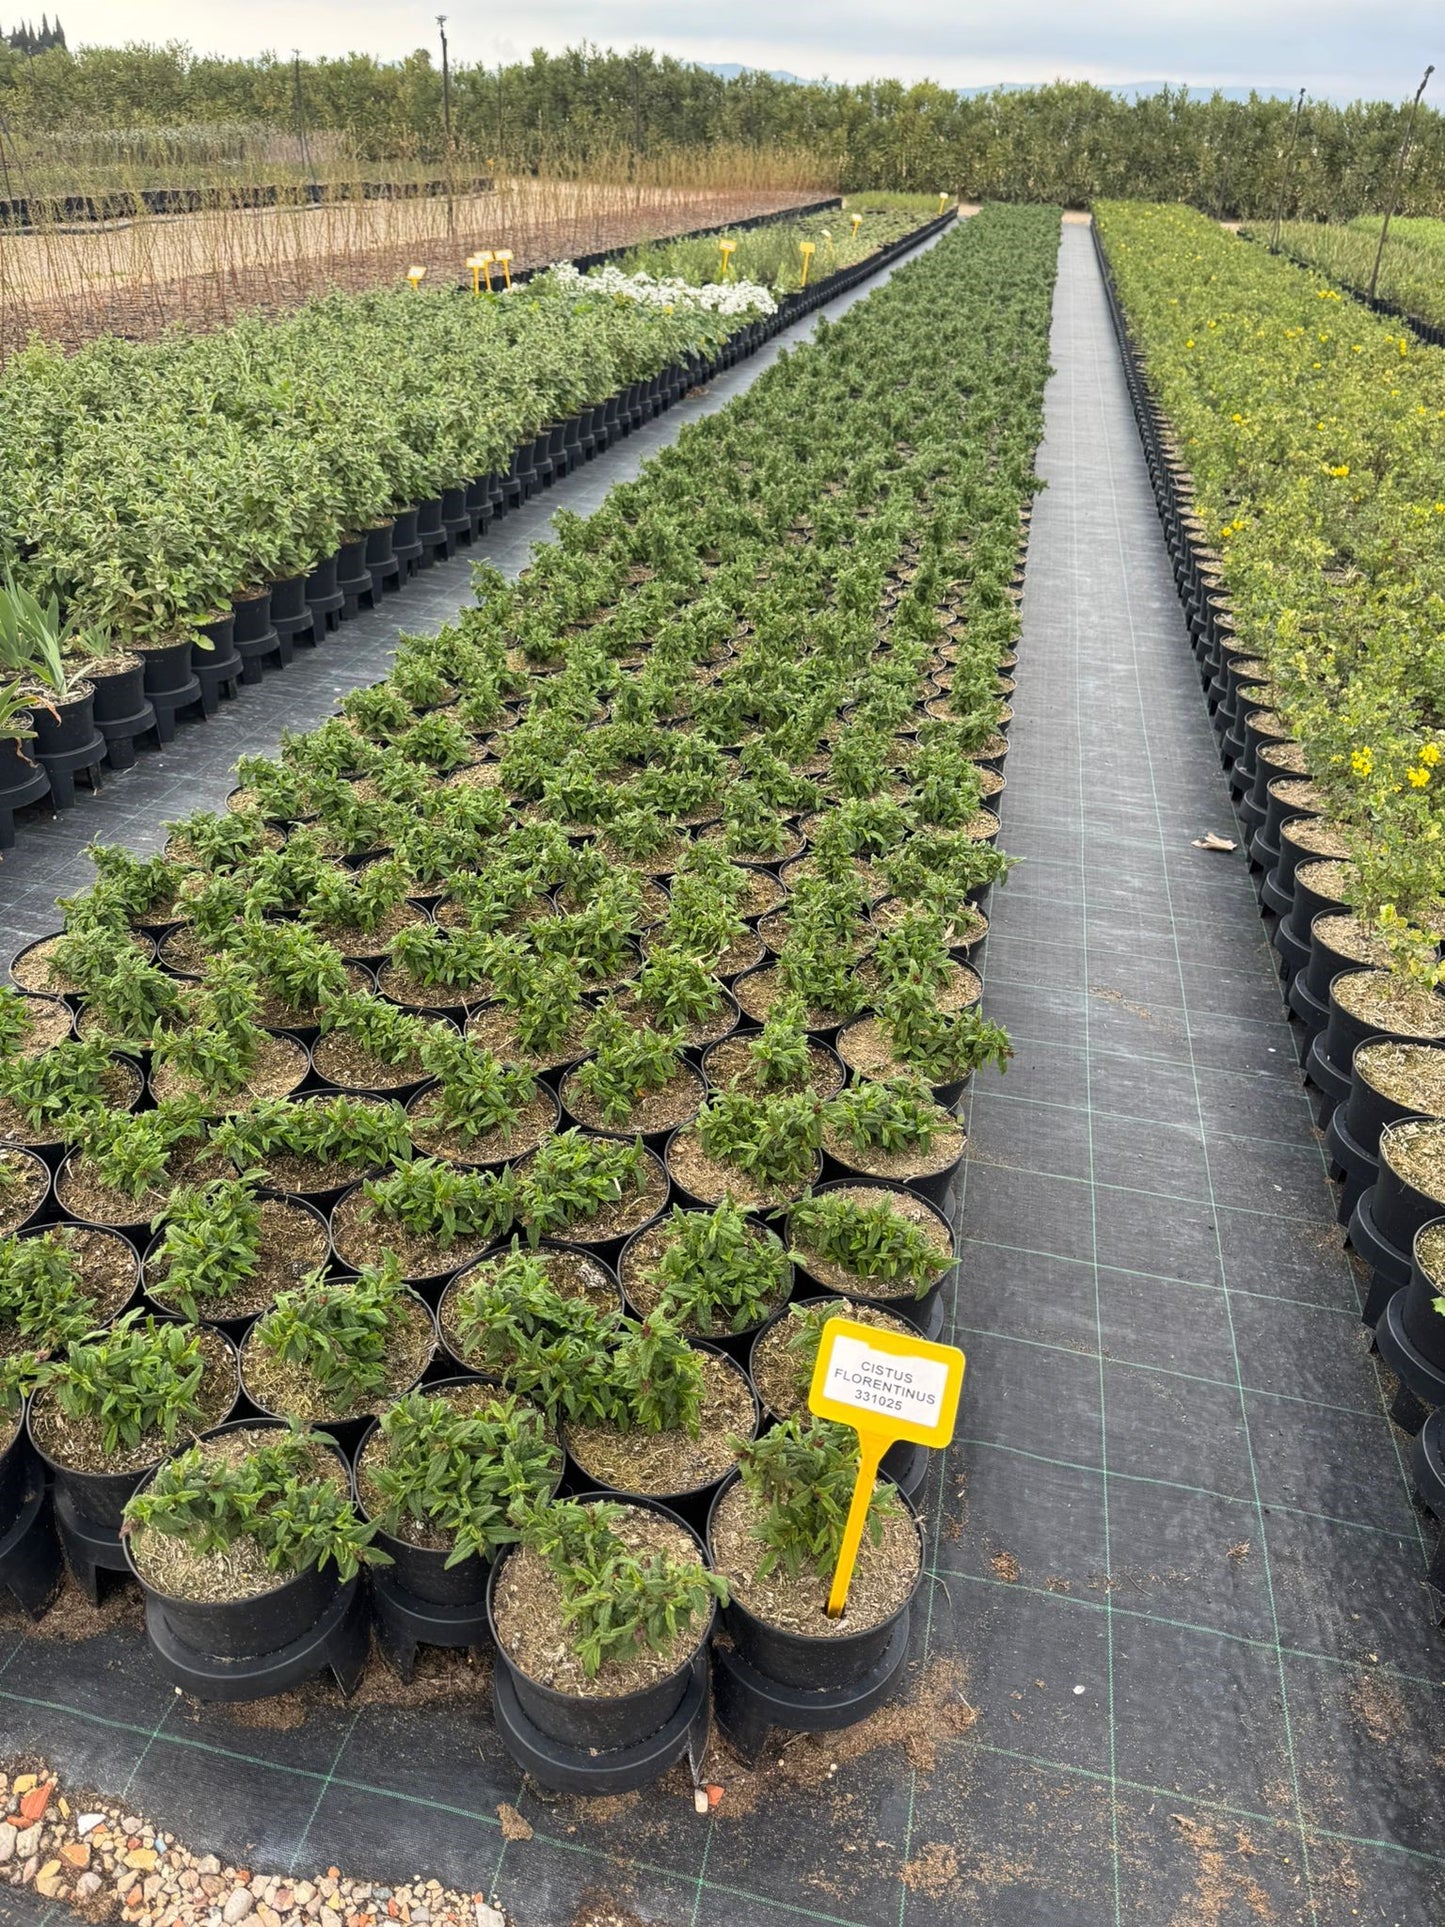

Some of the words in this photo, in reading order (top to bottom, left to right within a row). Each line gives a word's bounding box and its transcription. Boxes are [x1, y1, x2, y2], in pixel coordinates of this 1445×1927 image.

[861, 1361, 913, 1384] CISTUS
[834, 1368, 936, 1405] FLORENTINUS
[854, 1389, 903, 1411] 331025
